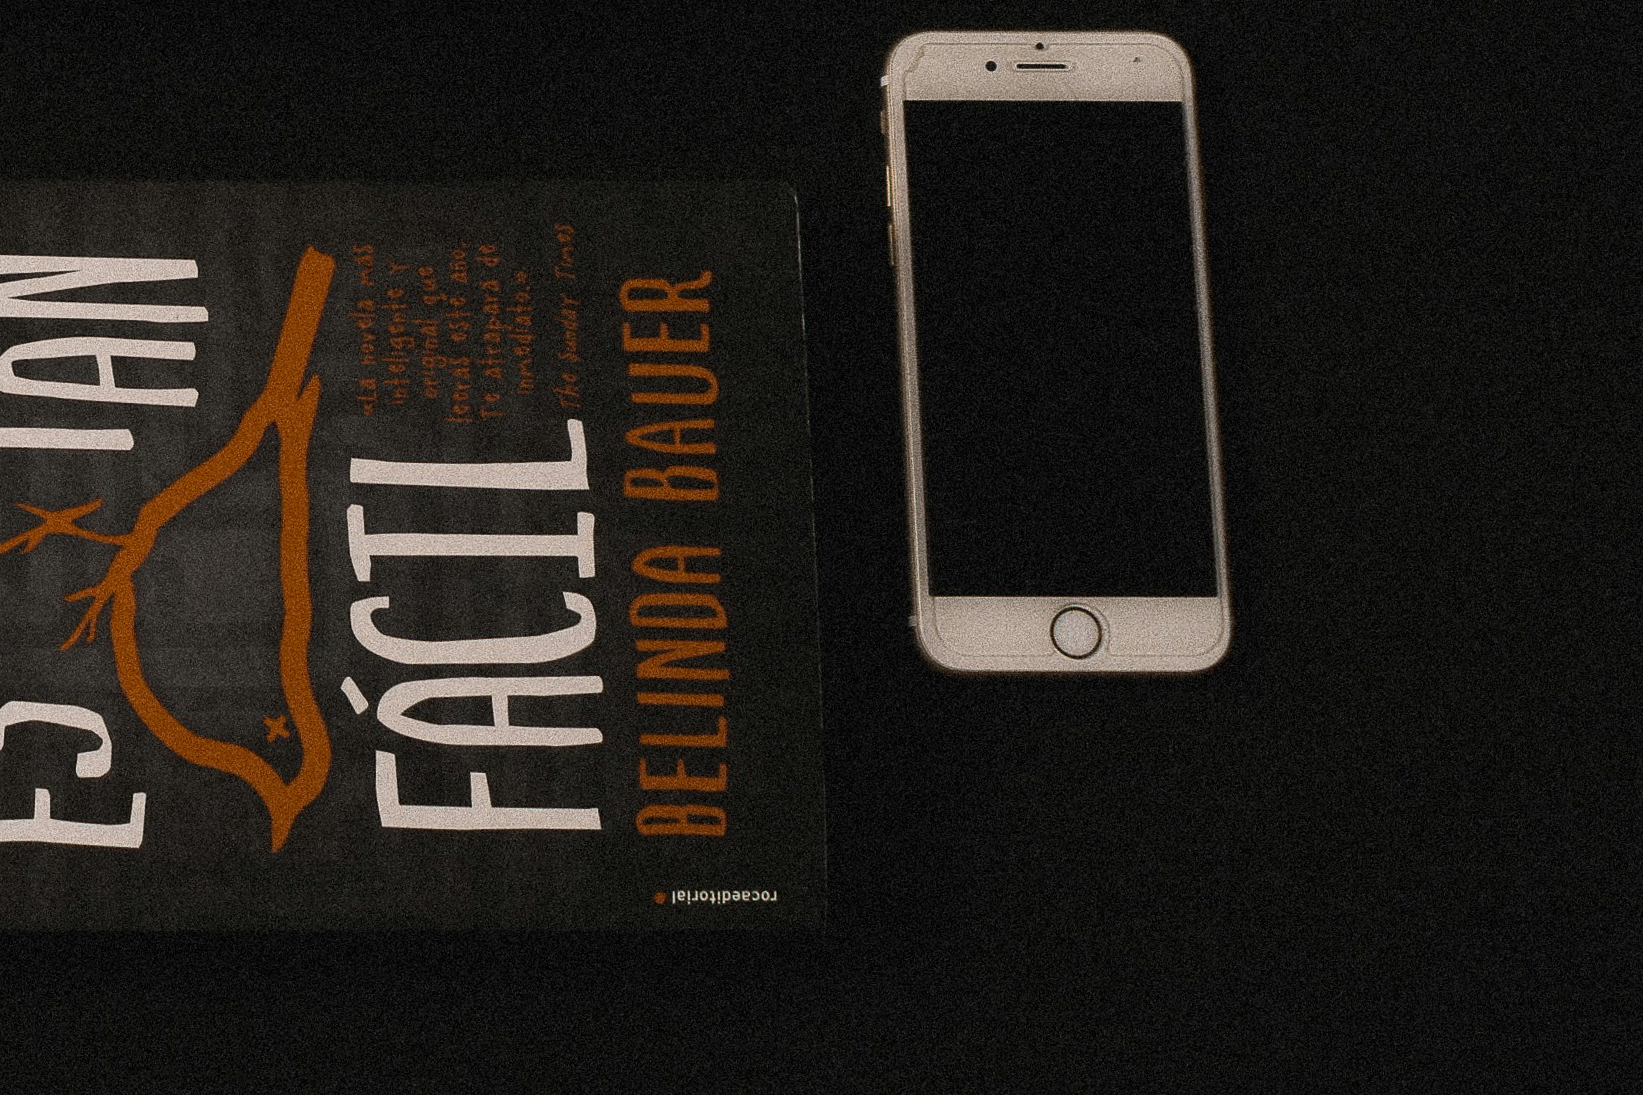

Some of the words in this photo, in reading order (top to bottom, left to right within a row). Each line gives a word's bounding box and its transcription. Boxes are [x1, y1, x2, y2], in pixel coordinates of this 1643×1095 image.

[474, 243, 502, 268] de
[553, 223, 577, 280] Times
[347, 299, 377, 366] novela
[379, 288, 417, 405] inteligente
[442, 296, 472, 343] este
[408, 319, 449, 400] original
[553, 372, 582, 408] The
[619, 270, 719, 501] BAUER
[478, 392, 507, 421] Te
[336, 419, 603, 830] FÁCIL
[629, 545, 730, 836] BELINDA
[672, 889, 779, 905] rocaeditorial
